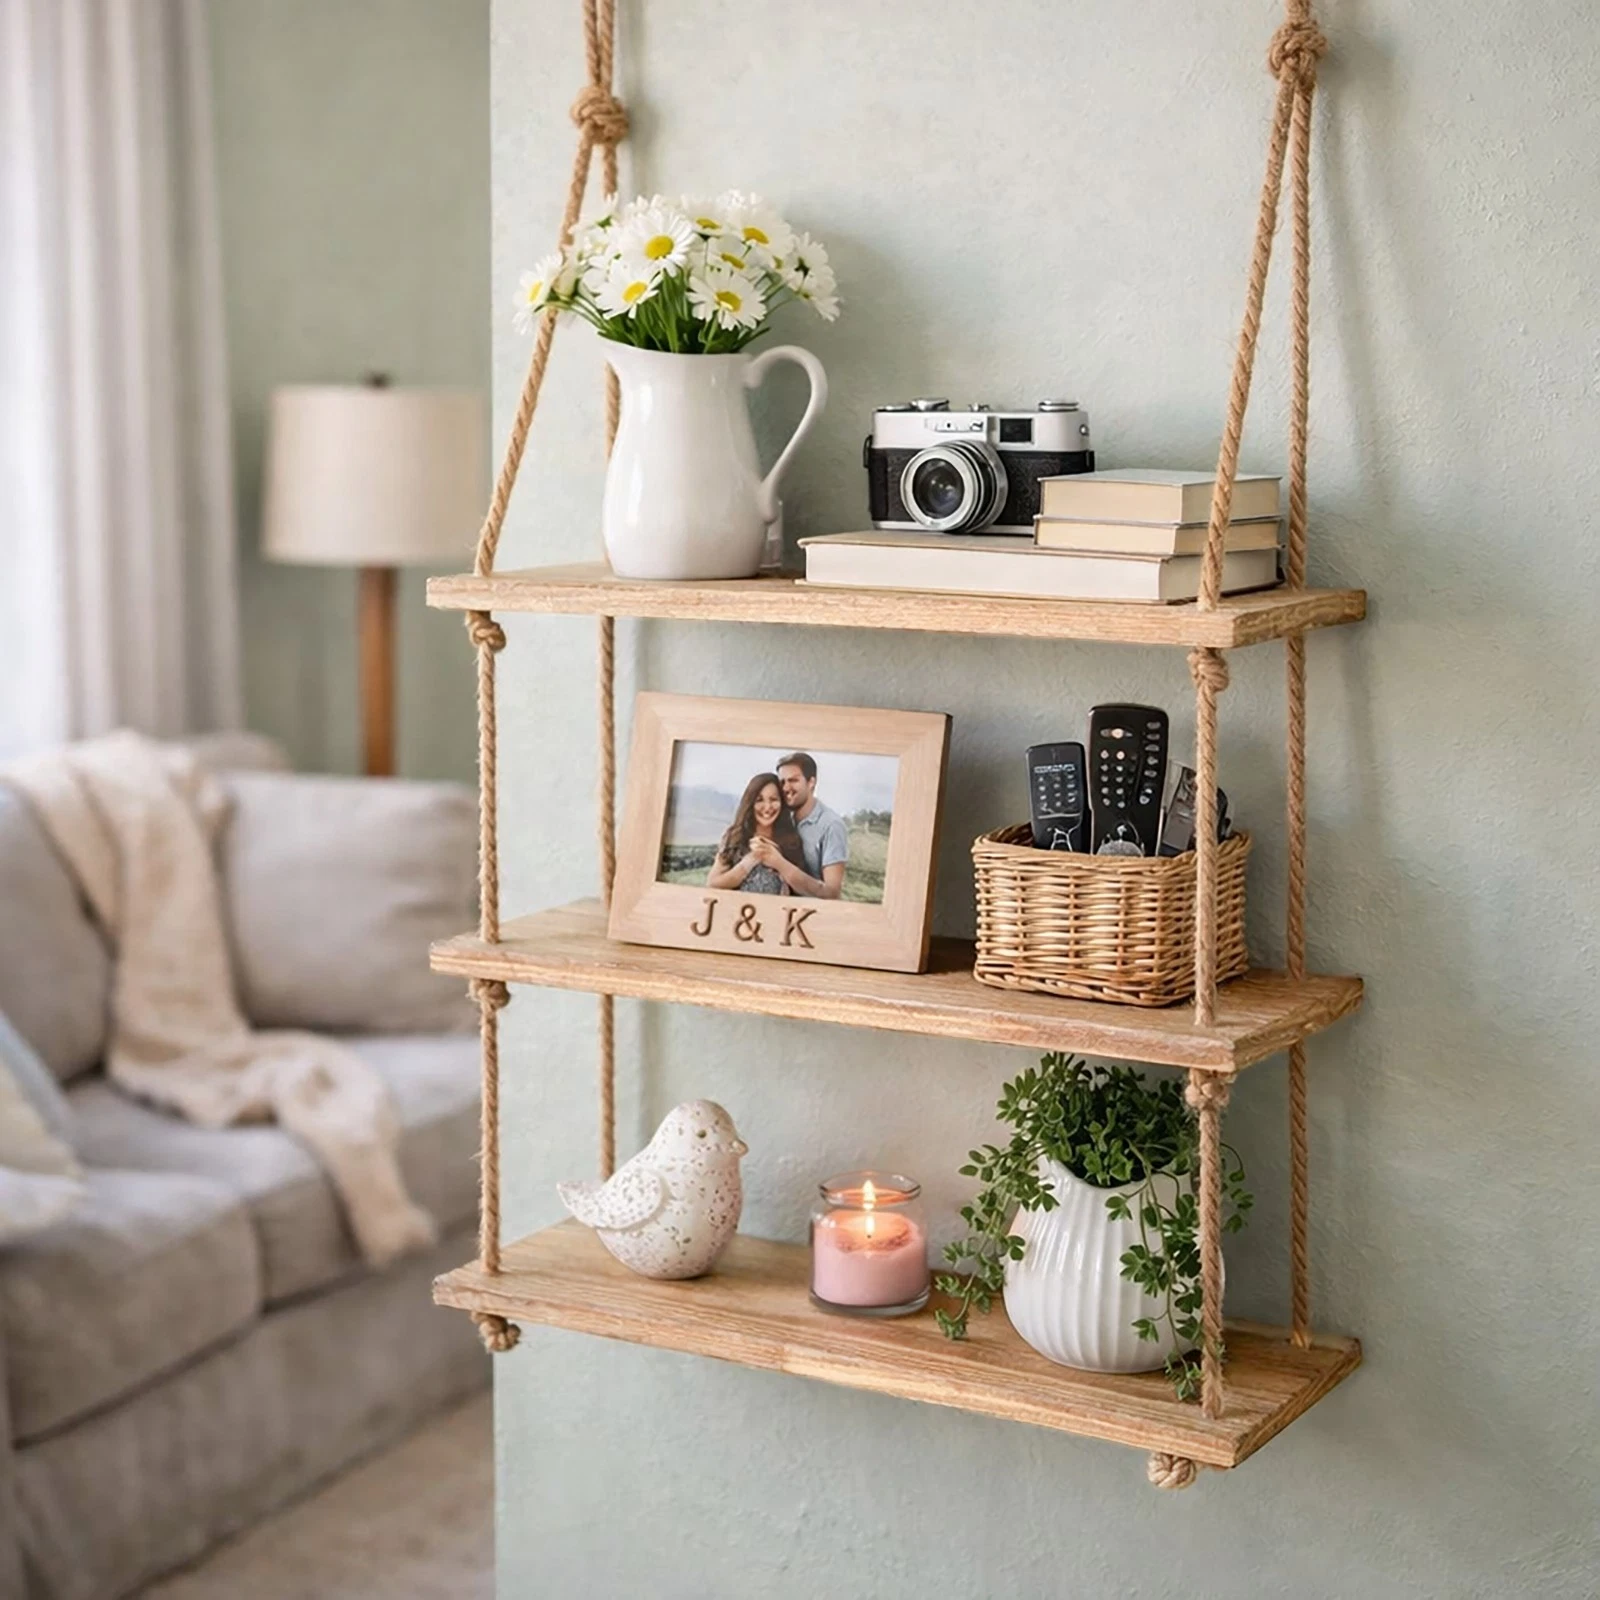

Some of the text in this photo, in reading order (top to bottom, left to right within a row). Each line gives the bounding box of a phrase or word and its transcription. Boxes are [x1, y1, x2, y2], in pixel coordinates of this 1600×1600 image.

[690, 898, 817, 949] J & K
